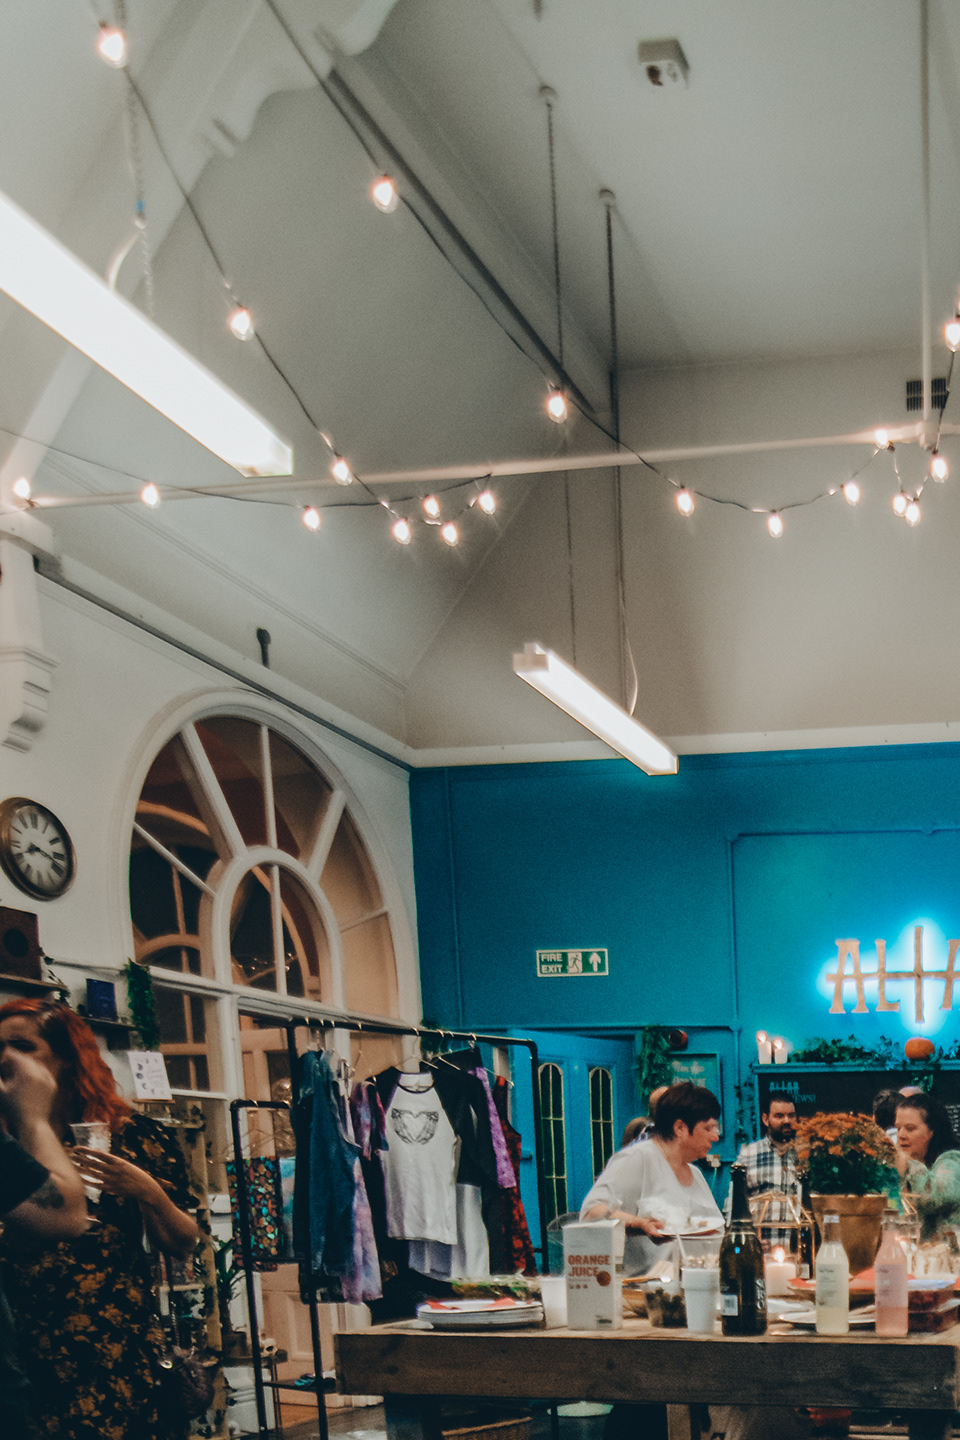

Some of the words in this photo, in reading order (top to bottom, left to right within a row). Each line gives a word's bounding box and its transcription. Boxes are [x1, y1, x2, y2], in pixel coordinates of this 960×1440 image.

[541, 953, 563, 962] FIRE
[541, 964, 563, 974] EXIT
[568, 1255, 610, 1266] ORANGE
[568, 1266, 599, 1277] JUICE
